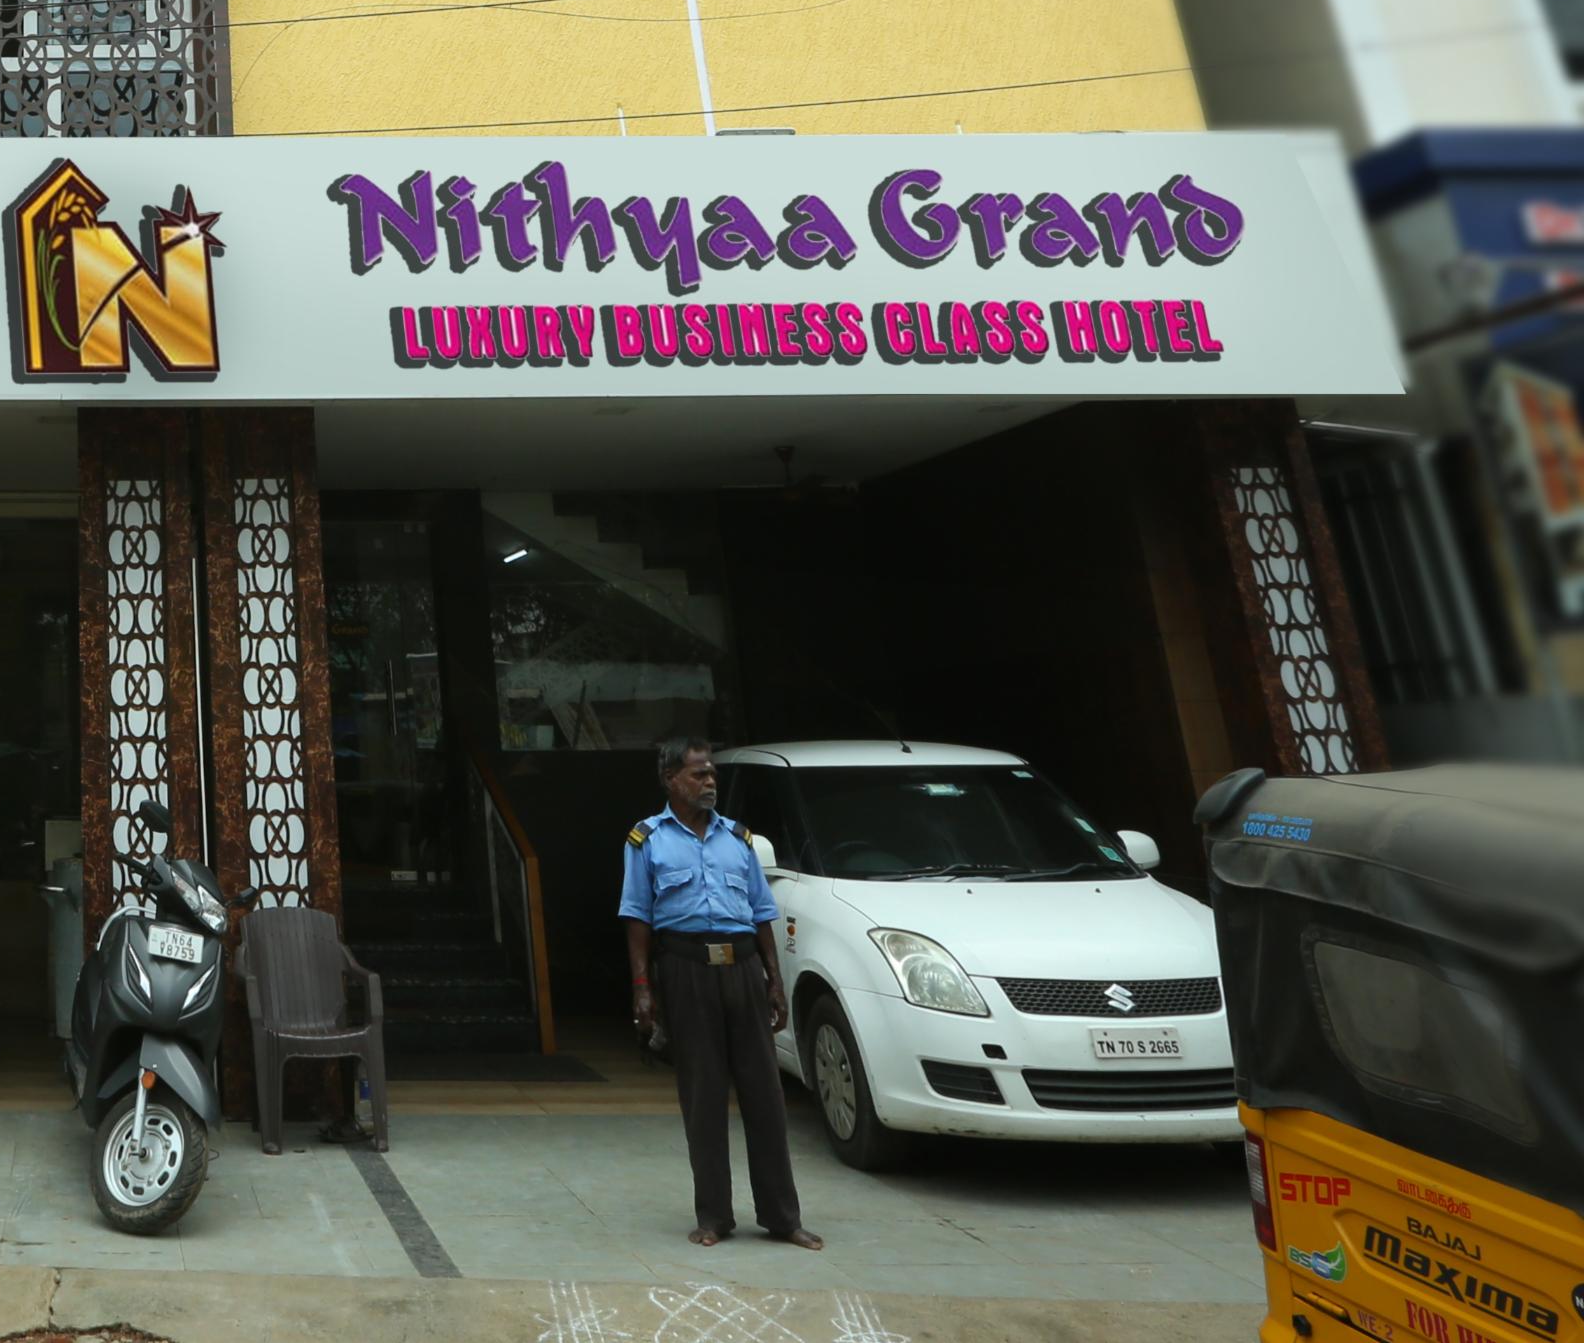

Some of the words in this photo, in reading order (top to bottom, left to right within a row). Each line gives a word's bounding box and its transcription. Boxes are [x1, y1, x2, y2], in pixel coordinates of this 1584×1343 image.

[338, 160, 858, 288] Nithyaa
[880, 169, 1245, 260] Grand
[401, 306, 595, 359] LUXURY
[615, 302, 869, 358] BUSINESS
[884, 301, 1050, 355] CLASS
[1063, 299, 1225, 354] HOTEL
[1097, 1041, 1116, 1053] TN
[1118, 1041, 1134, 1053] 70
[1137, 1041, 1146, 1053] S
[1279, 1172, 1352, 1206] STOP
[1407, 1216, 1481, 1261] BAJAJ
[1405, 1298, 1450, 1343] FOR
